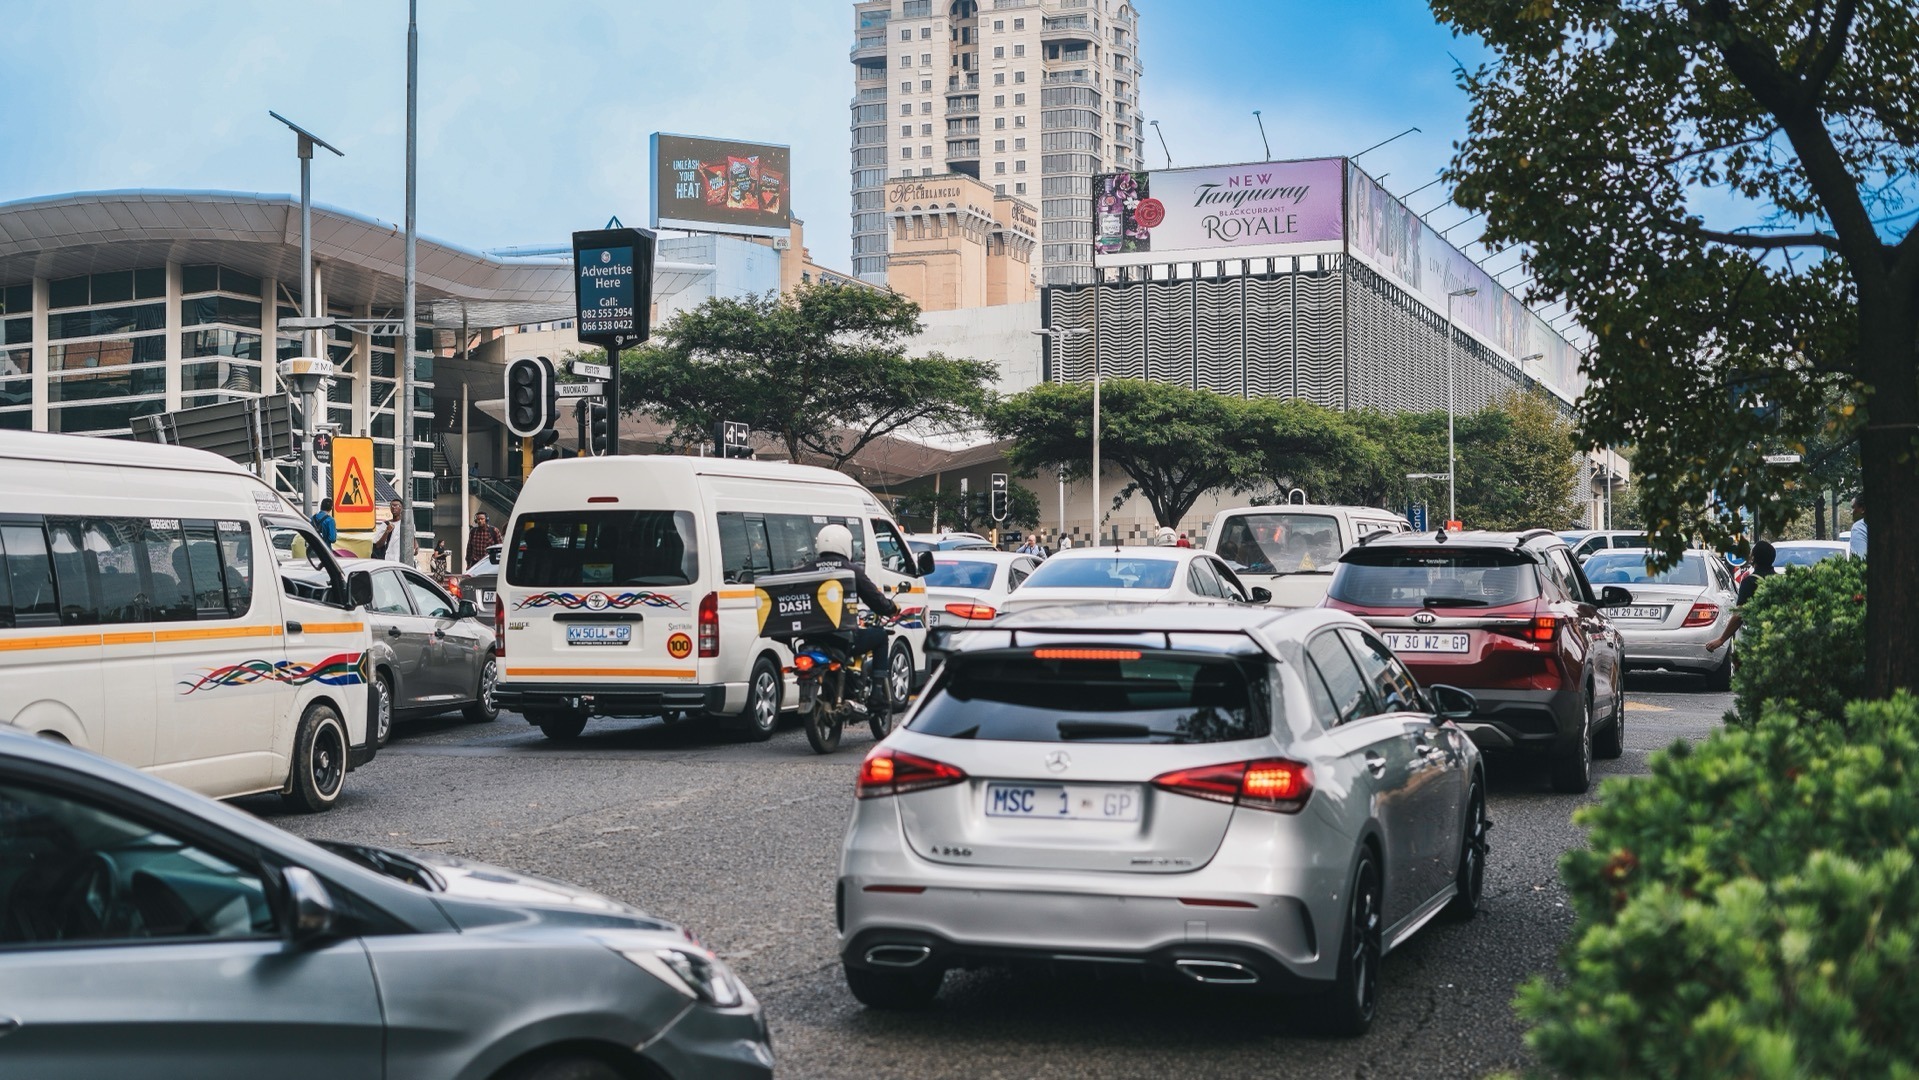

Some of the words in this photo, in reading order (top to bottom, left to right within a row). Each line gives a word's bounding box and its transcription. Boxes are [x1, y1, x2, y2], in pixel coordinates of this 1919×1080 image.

[673, 159, 700, 171] UNLEASH
[679, 171, 695, 182] YOUR
[1228, 173, 1273, 188] NEW
[676, 183, 700, 199] HEAT
[889, 184, 961, 203] MICHELANGELO
[1193, 183, 1310, 208] Tanqueray
[1219, 206, 1285, 217] BLACKCURRANT
[1201, 214, 1298, 242] ROYALE
[581, 264, 632, 277] Advertise
[595, 278, 621, 288] Here
[600, 297, 618, 307] Call:
[582, 309, 596, 319] 082
[598, 309, 612, 318] 555
[614, 308, 632, 317] 2954
[582, 322, 596, 331] 066
[598, 321, 612, 330] 538
[614, 320, 632, 329] 0422
[582, 385, 588, 394] RD
[777, 593, 811, 602] WOOLIES
[779, 600, 811, 612] DASH
[1609, 608, 1618, 616] CN
[1621, 608, 1631, 616] 29
[1634, 608, 1643, 617] ZX
[1649, 608, 1659, 617] GP
[1416, 615, 1433, 623] KIA
[569, 627, 581, 639] KW
[583, 627, 594, 638] 50
[595, 627, 607, 639] LL
[616, 628, 629, 639] GP
[670, 640, 689, 651] 100
[1405, 635, 1419, 649] 30
[1425, 635, 1438, 649] WZ
[1452, 636, 1467, 649] GP
[993, 788, 1035, 812] MSC
[1059, 790, 1069, 815] 1
[1103, 793, 1131, 817] GP
